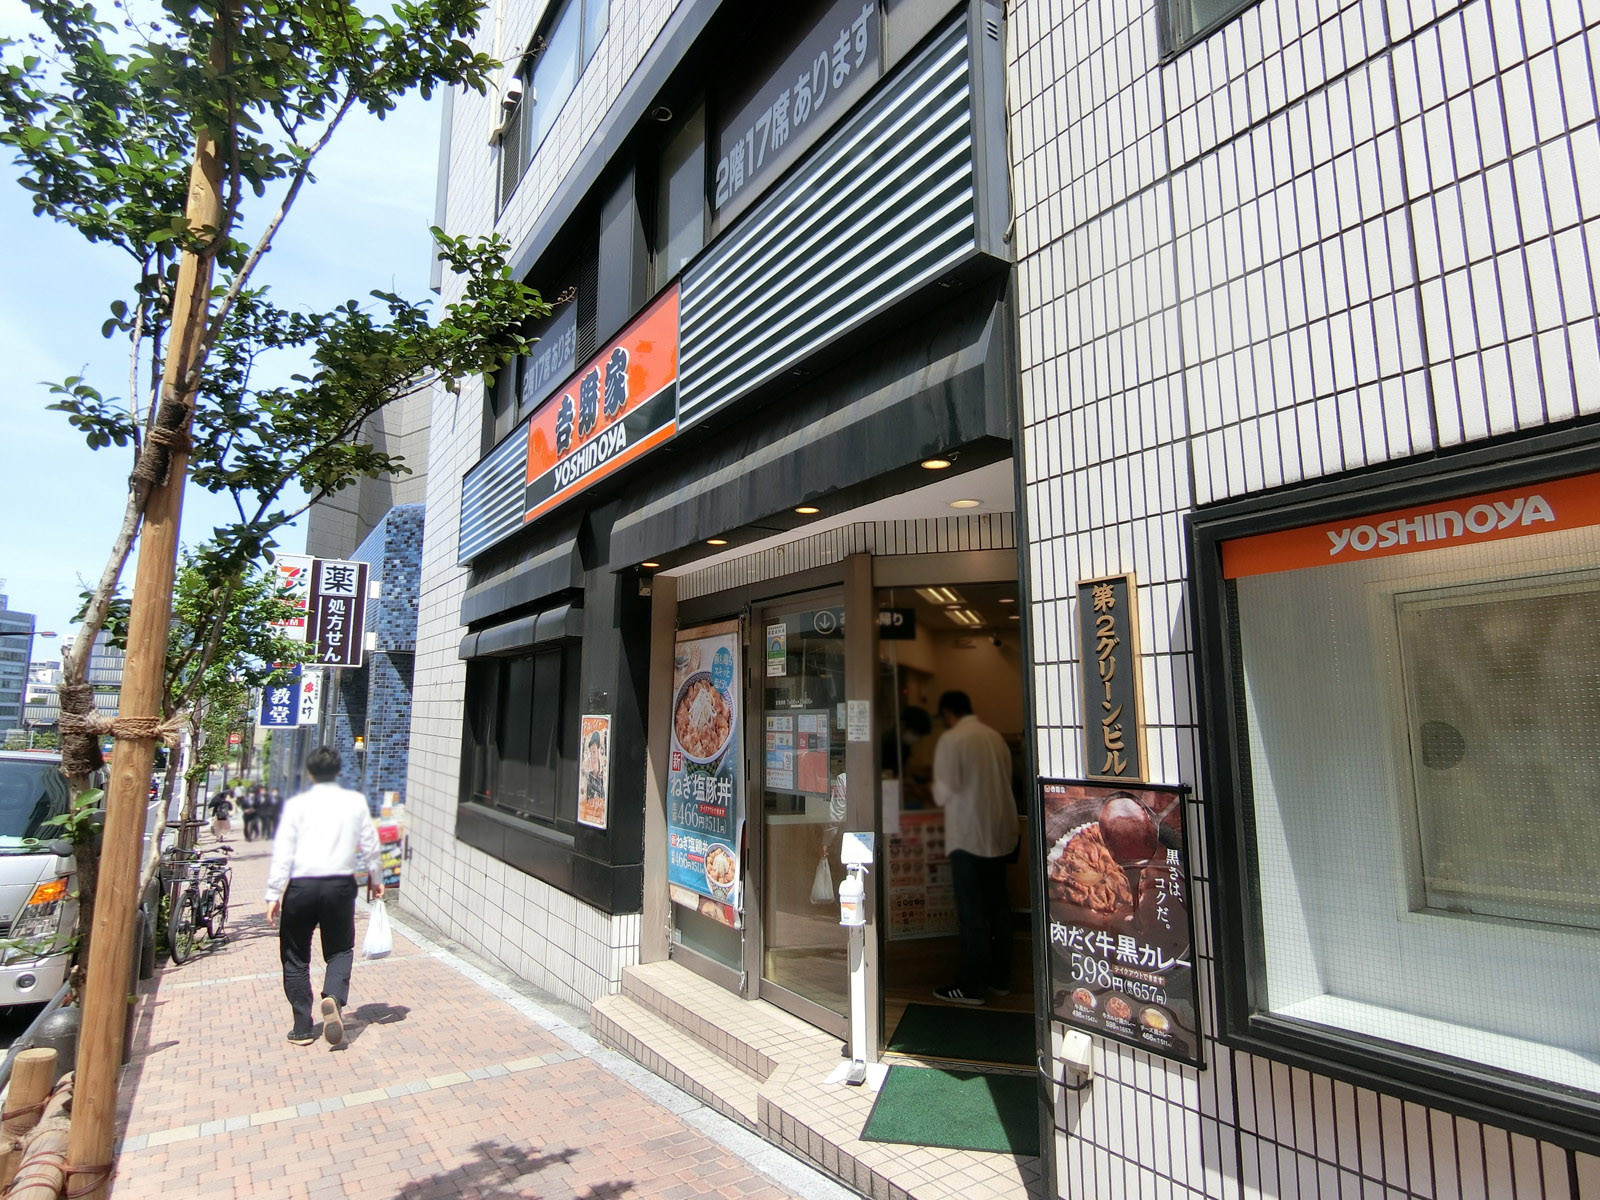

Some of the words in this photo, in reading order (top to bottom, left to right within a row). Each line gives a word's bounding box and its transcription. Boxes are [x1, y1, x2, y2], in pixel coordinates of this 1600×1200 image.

[715, 3, 874, 210] 2階17席あります
[555, 346, 630, 457] 吉野家
[553, 421, 627, 492] YOSHINOYA
[1326, 494, 1556, 556] YOSHINOYA
[324, 565, 355, 593] 薬
[323, 598, 346, 663] 処方せん
[1091, 583, 1128, 775] 第2グリーンビル
[671, 774, 731, 806] ねぎ塩豚丼
[1154, 877, 1171, 930] コクだ。
[1166, 848, 1183, 903] 黒さは、
[1050, 921, 1192, 969] 肉だく牛黒カレー
